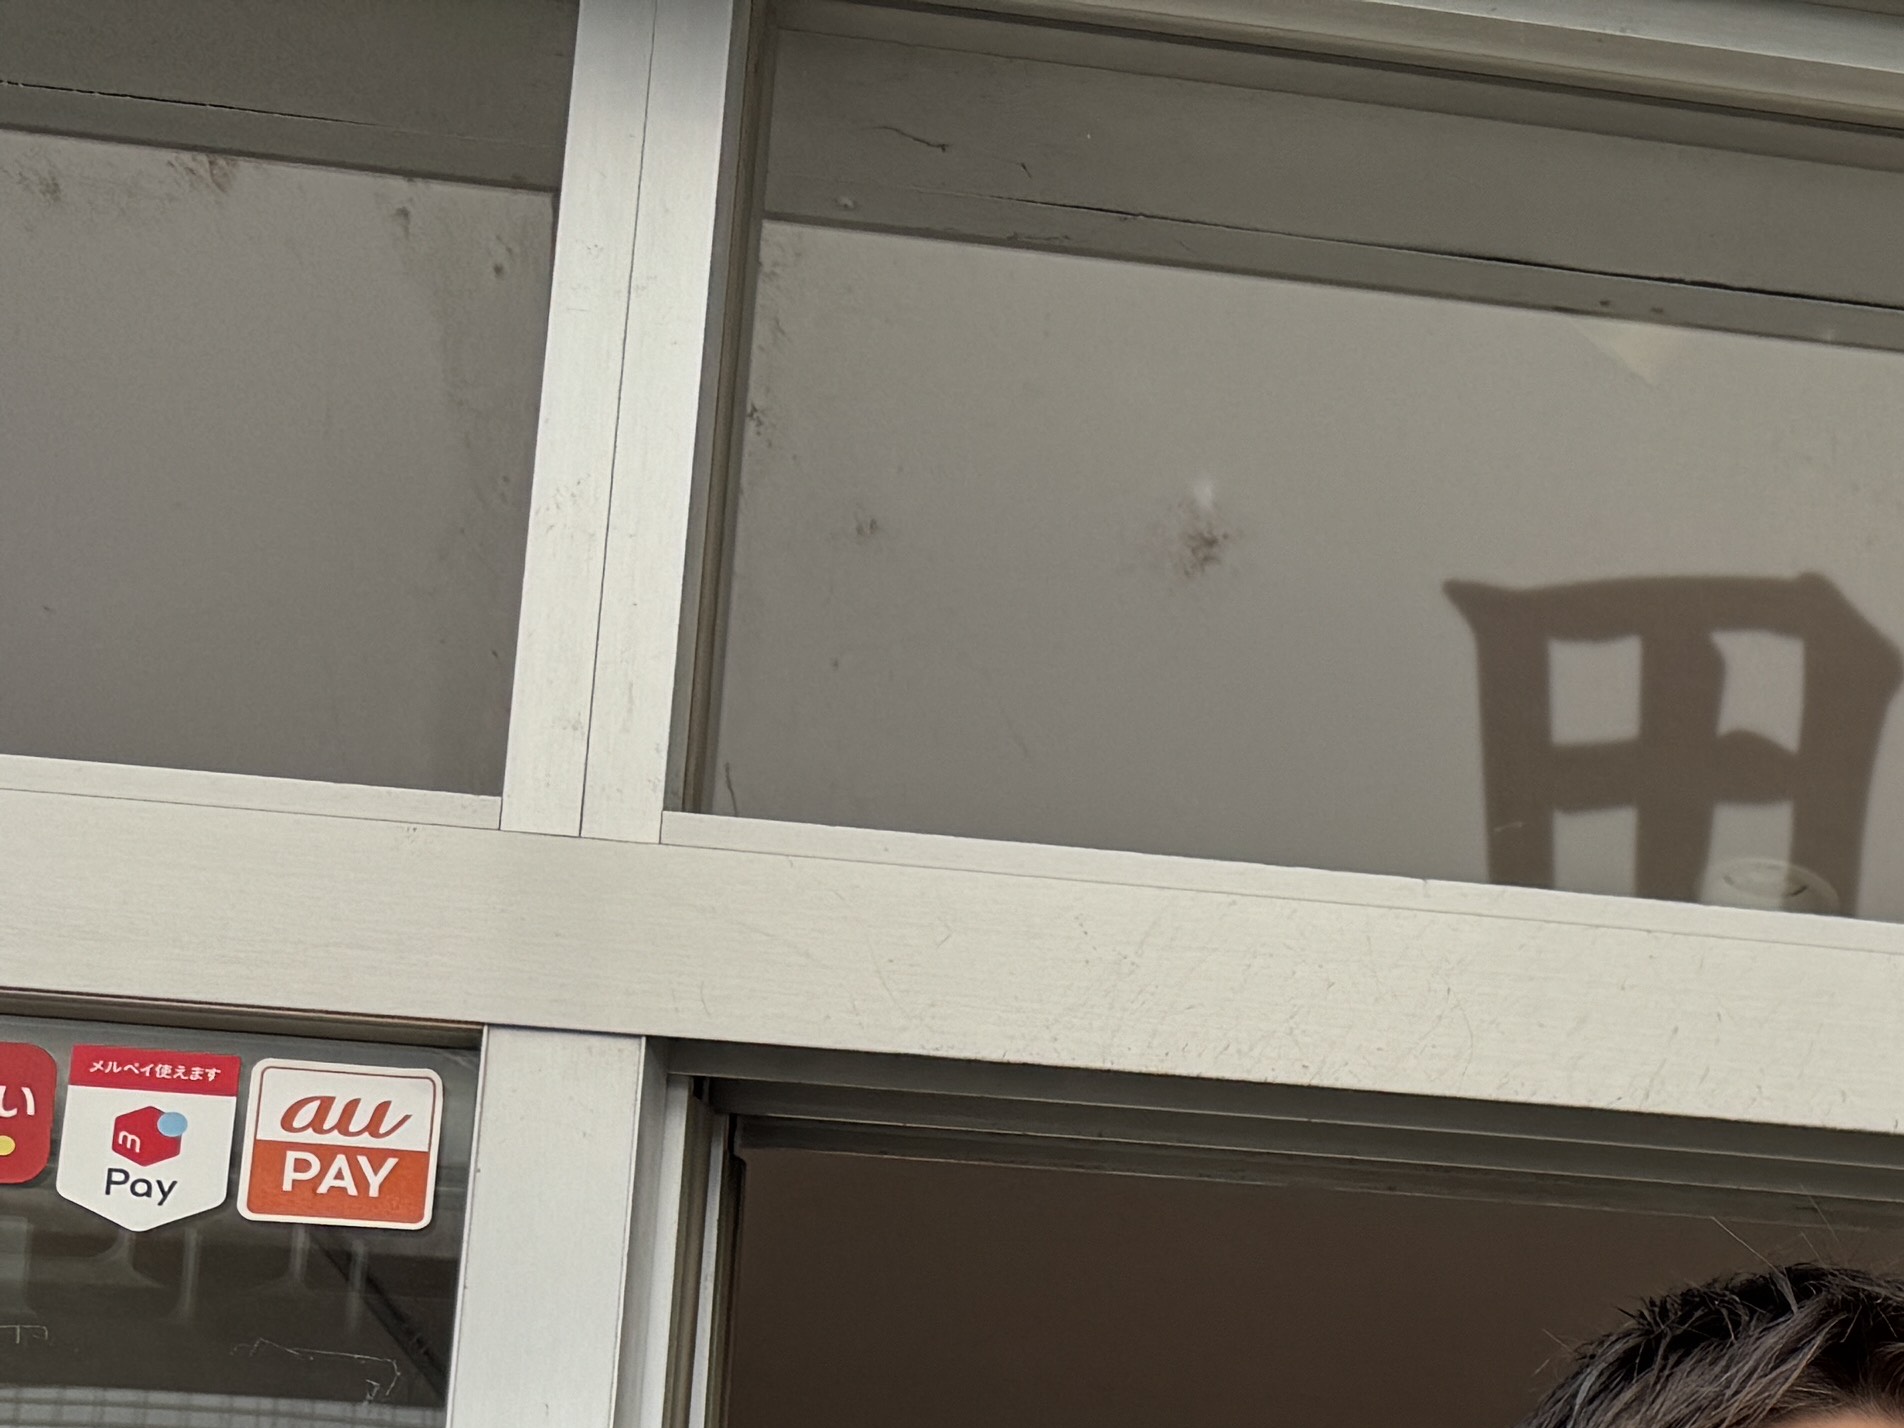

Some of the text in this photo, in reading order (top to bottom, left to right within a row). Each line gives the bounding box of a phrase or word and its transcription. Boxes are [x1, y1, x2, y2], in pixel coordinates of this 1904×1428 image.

[90, 1059, 221, 1082] メルペイ使えます
[280, 1095, 412, 1139] au
[104, 1167, 178, 1206] Pay
[282, 1150, 400, 1198] PAY
